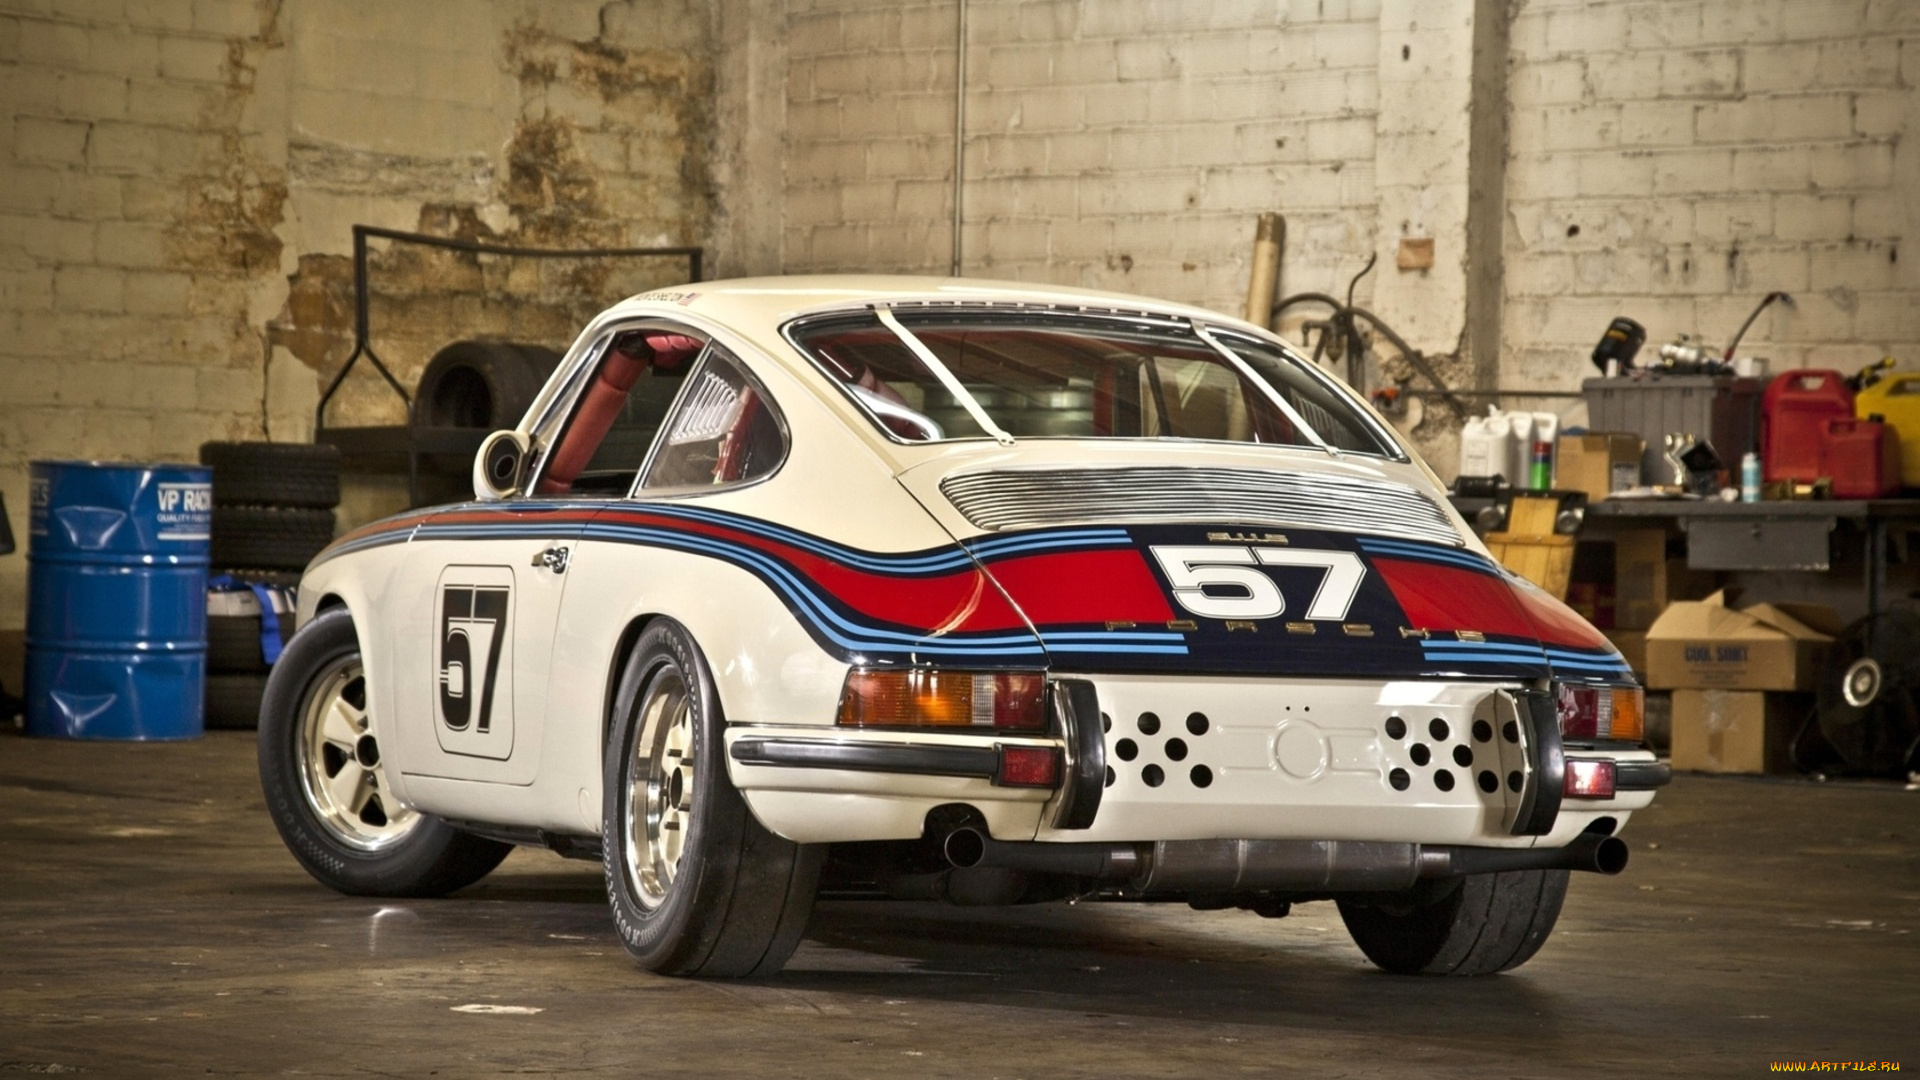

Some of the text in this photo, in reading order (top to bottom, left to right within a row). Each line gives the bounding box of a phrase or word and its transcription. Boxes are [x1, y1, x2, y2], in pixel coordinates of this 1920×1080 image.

[158, 489, 180, 511] VP
[1148, 544, 1367, 621] 57
[1105, 620, 1487, 643] PORSCHE
[439, 584, 510, 734] 57
